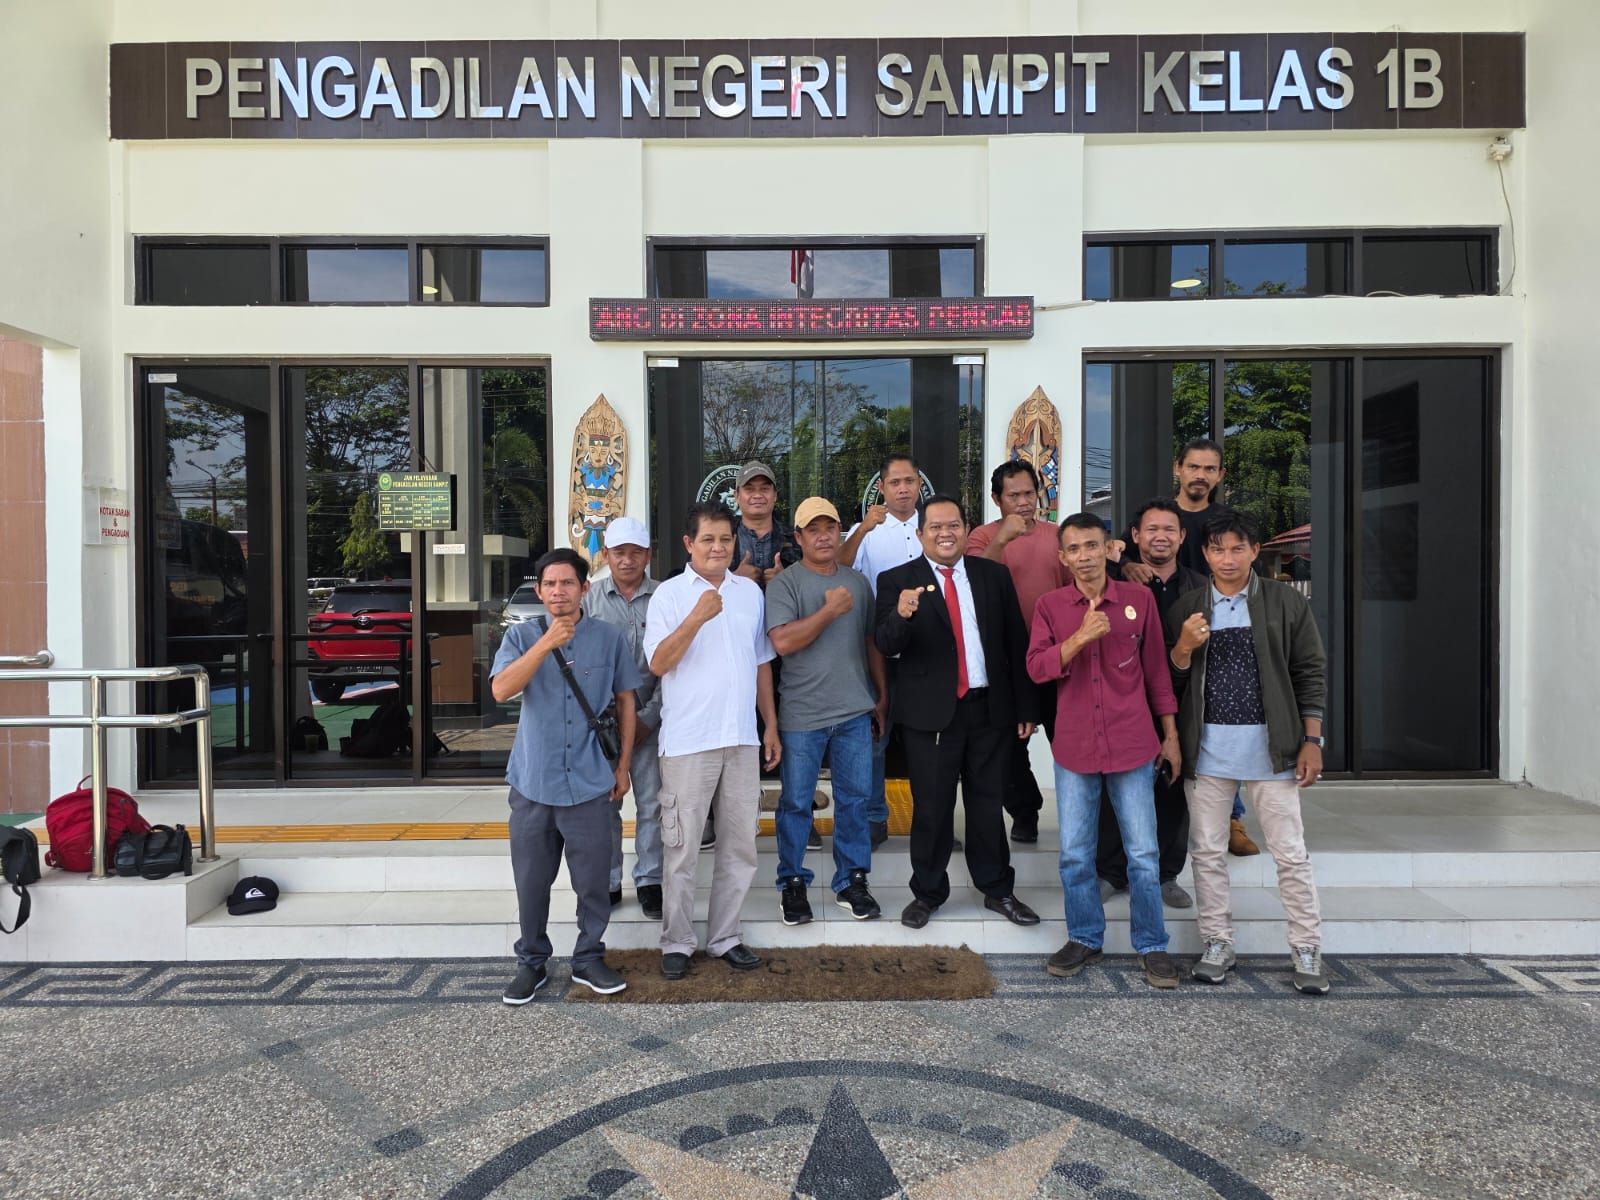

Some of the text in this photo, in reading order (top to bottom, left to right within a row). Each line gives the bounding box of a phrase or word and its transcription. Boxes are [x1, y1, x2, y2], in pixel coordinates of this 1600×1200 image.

[185, 47, 1445, 121] PENGADILAN NEGERI SAMPIT KELAS 1B
[660, 305, 685, 329] DI
[692, 305, 762, 329] ZONA
[100, 507, 130, 517] KOTAK SARAN
[102, 528, 130, 538] PENGADUAN
